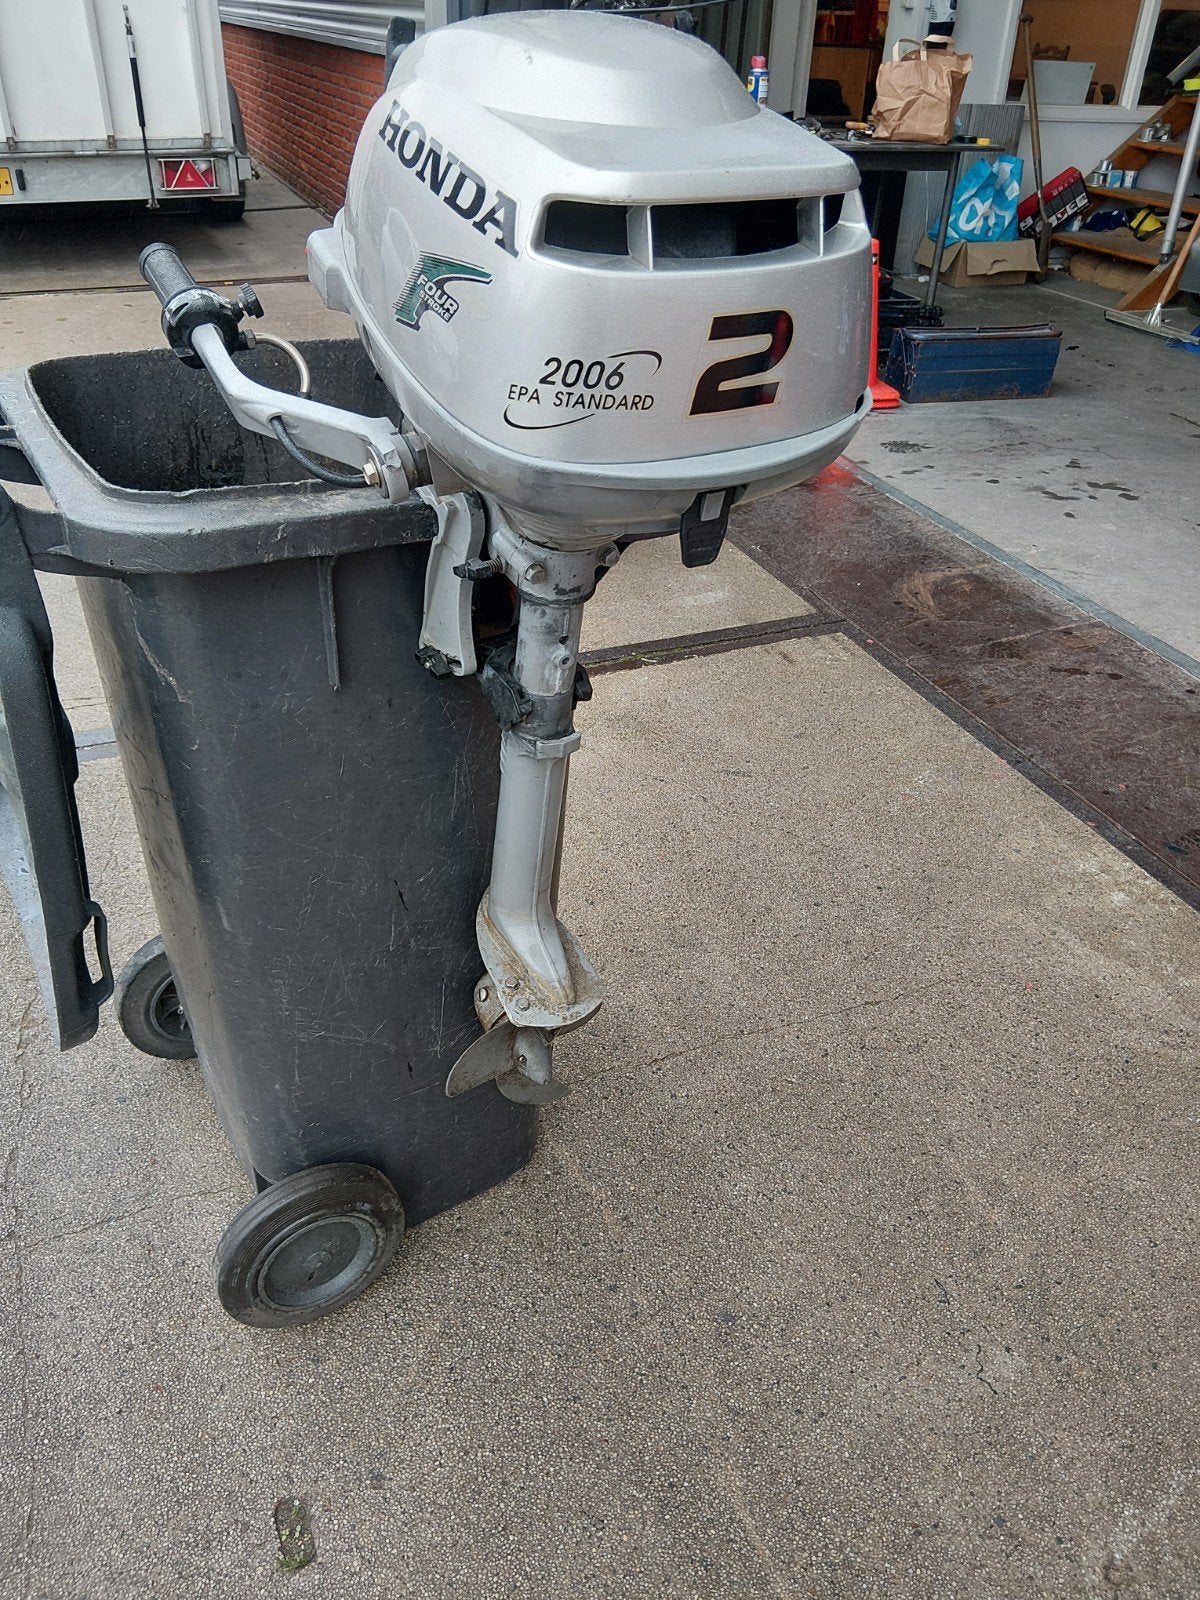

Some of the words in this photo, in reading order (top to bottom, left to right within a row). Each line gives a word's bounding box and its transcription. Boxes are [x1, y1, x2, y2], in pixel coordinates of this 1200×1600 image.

[378, 99, 519, 258] HONDA
[416, 274, 459, 315] FOUR
[418, 290, 452, 321] STROKE
[538, 357, 626, 390] 2006
[688, 309, 794, 417] 2
[508, 384, 541, 404] EPA
[553, 391, 655, 410] STANDARD
